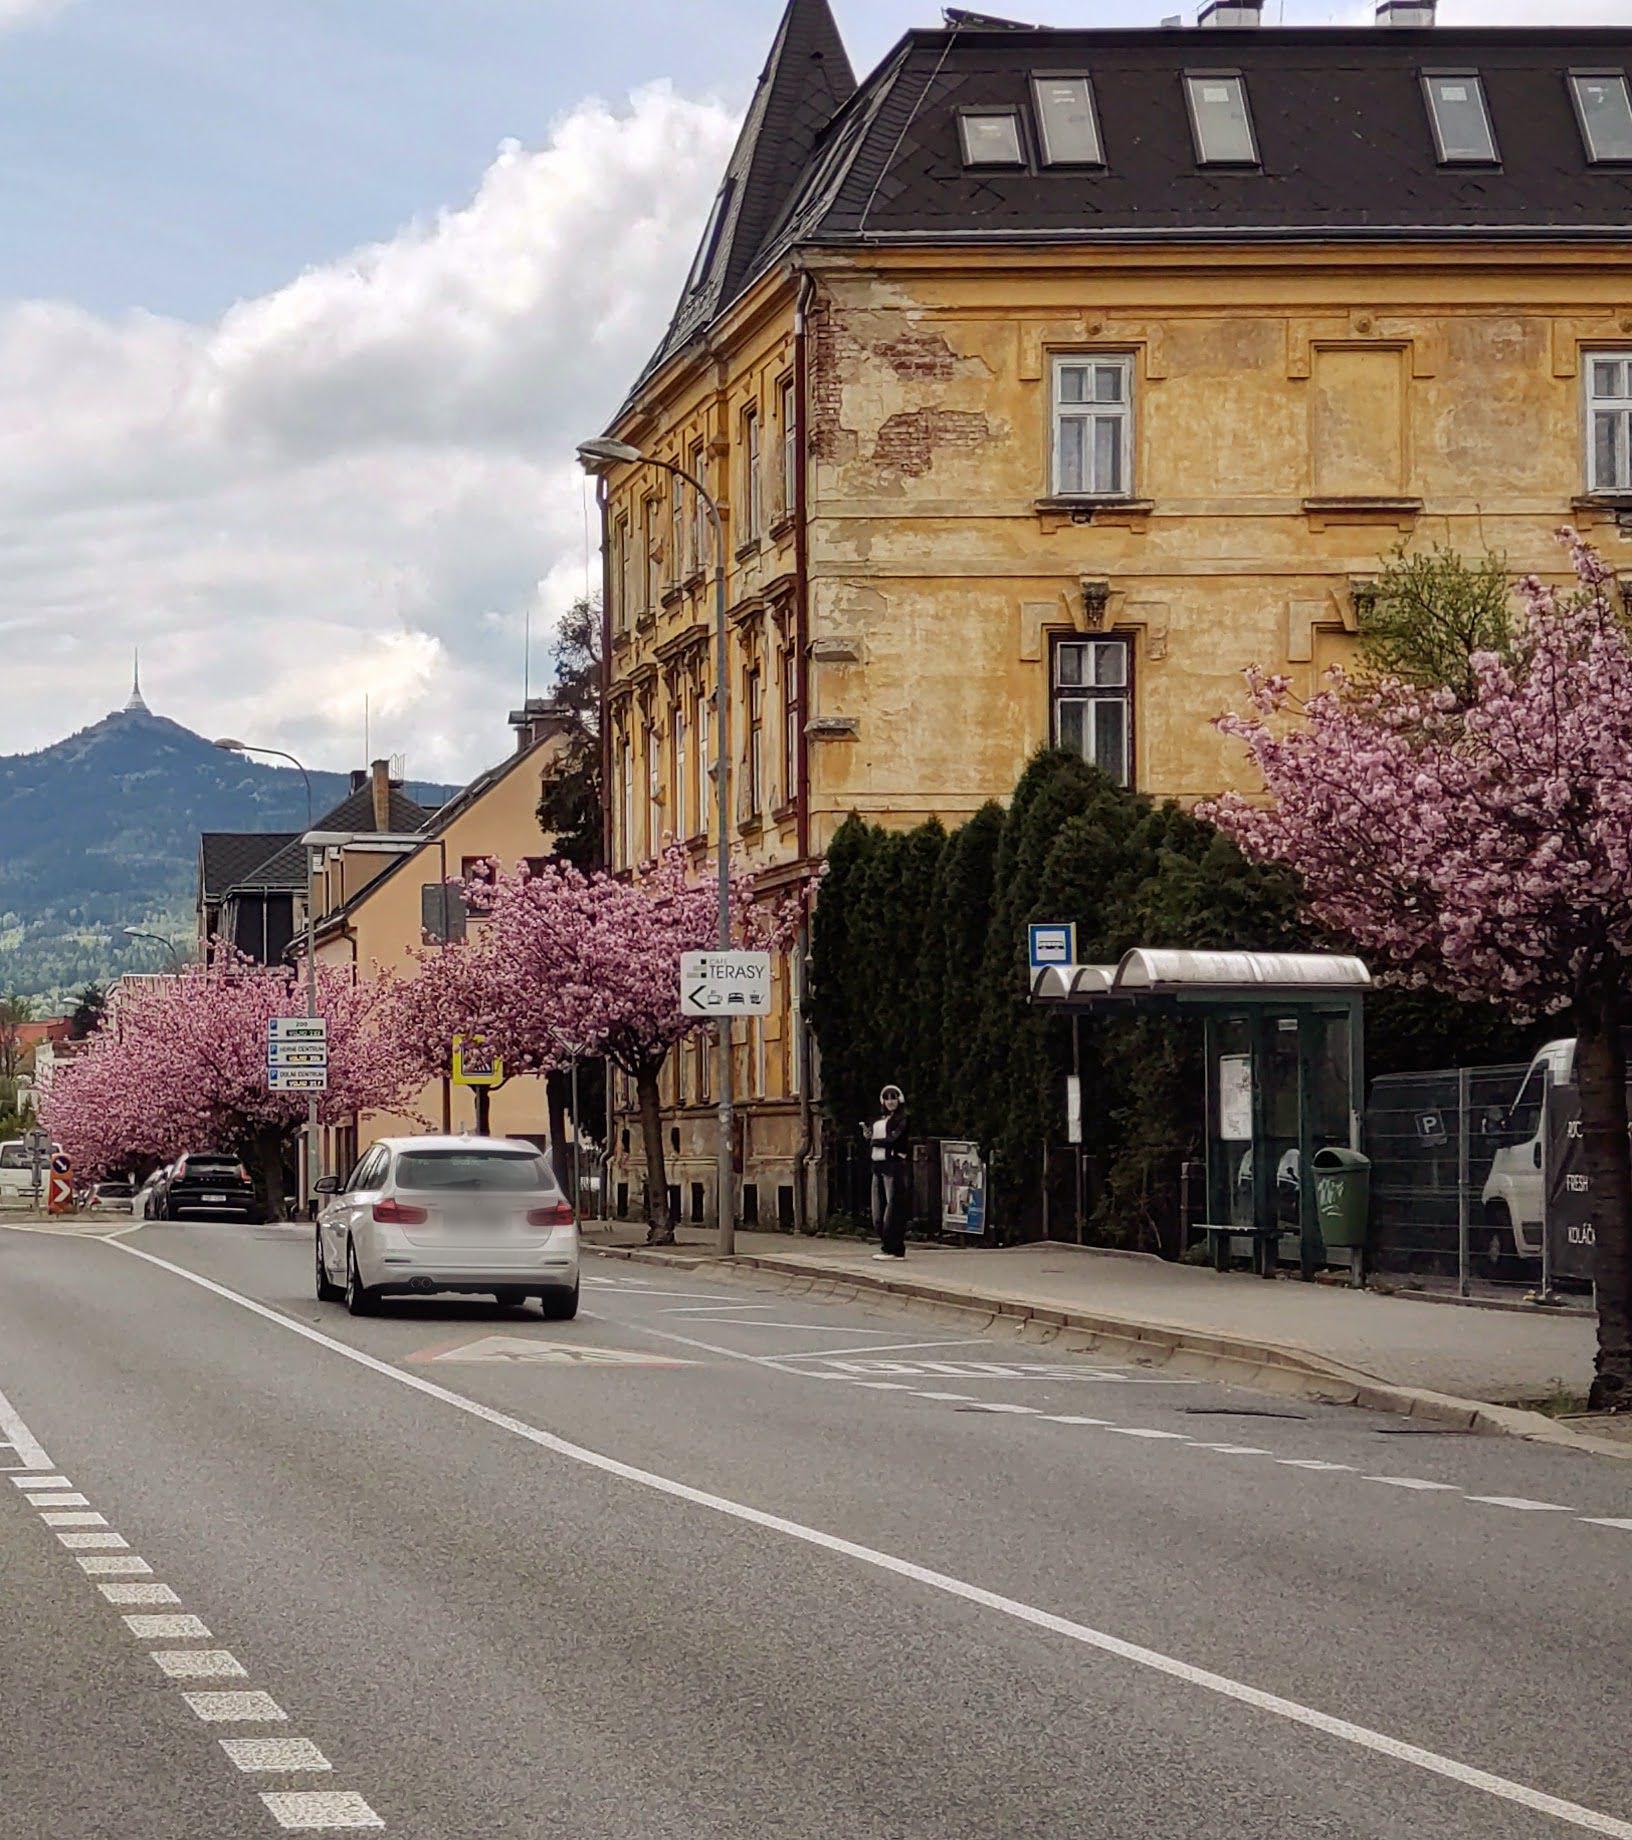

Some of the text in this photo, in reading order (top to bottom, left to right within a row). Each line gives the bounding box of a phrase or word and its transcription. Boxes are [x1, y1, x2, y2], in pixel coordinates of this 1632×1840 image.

[709, 965, 764, 979] TERASY
[1422, 1116, 1437, 1134] P
[1567, 1222, 1596, 1246] KOLÁČ
[821, 1361, 1129, 1379] BUS
